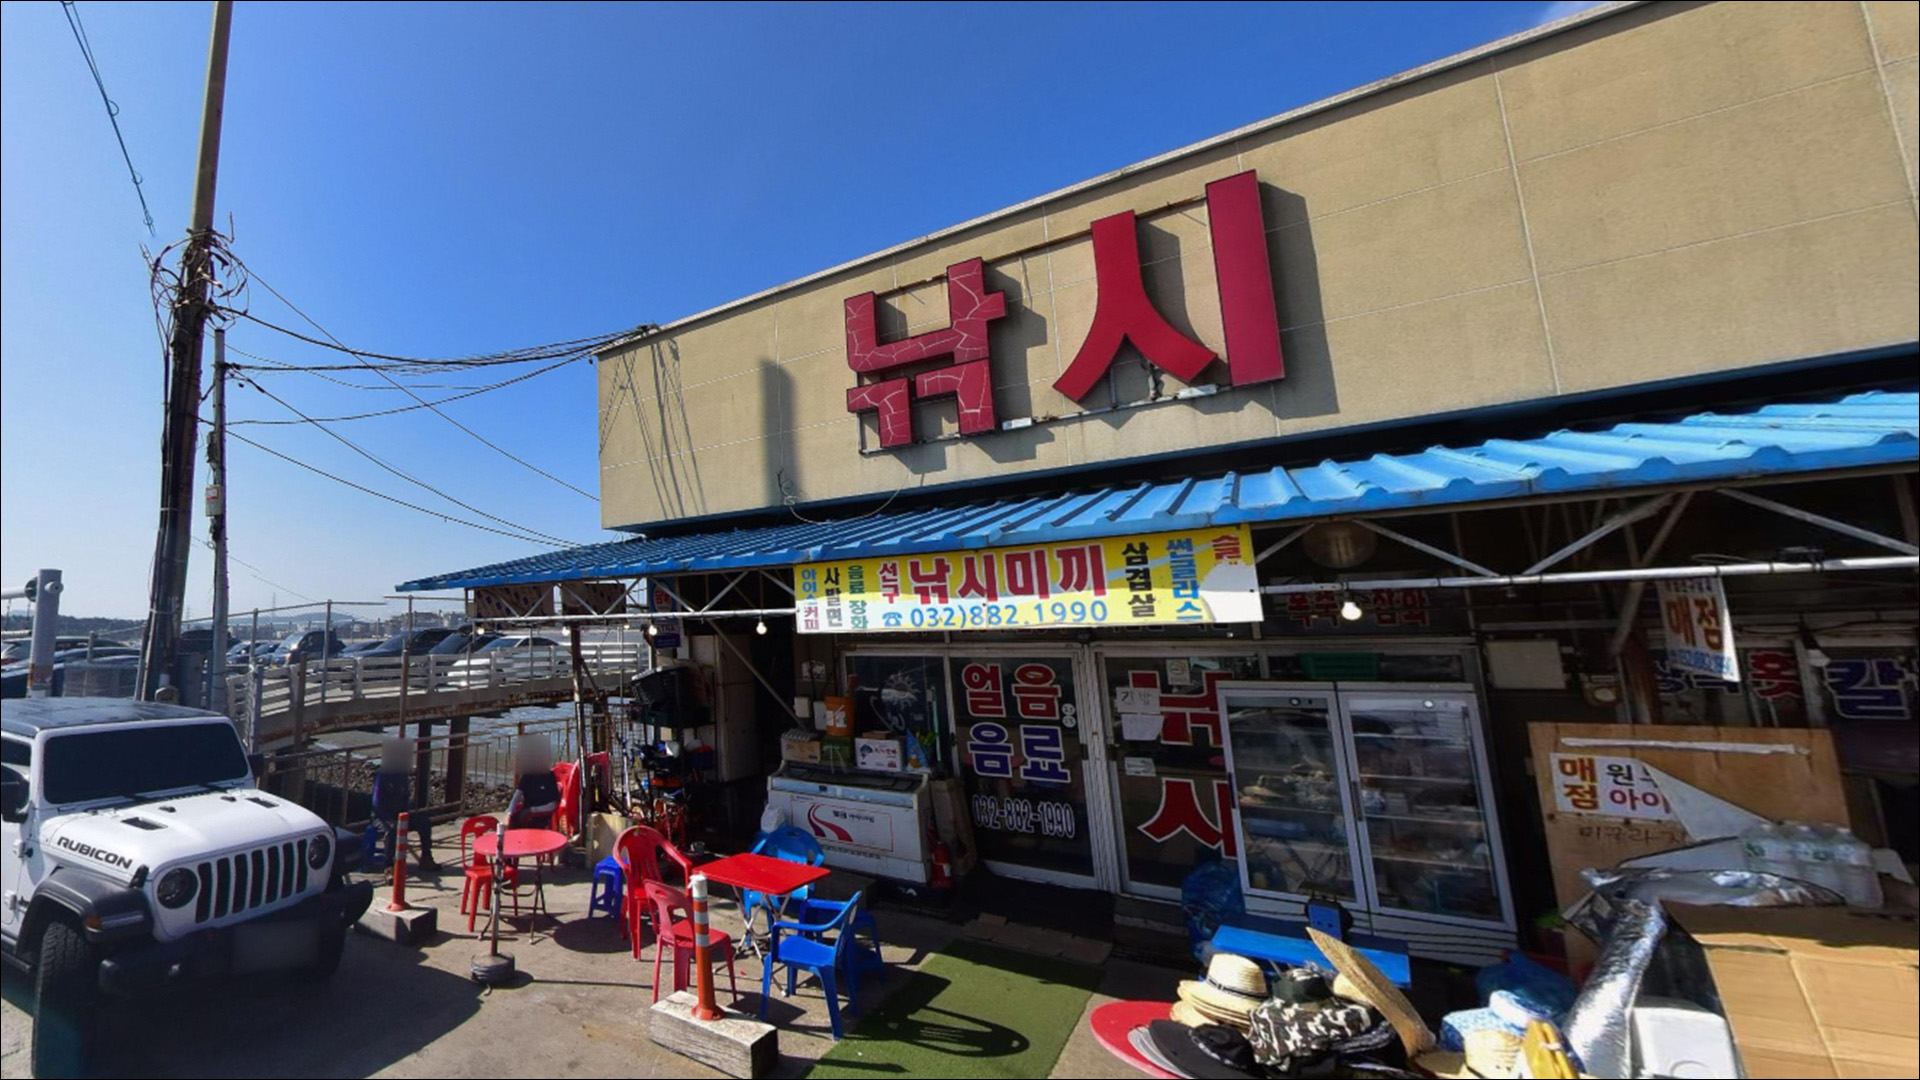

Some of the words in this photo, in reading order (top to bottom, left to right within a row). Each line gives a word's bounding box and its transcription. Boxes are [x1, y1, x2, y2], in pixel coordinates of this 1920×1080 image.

[844, 169, 1285, 447] 낚시
[824, 566, 843, 628] 사발면
[878, 561, 900, 604] 선구
[908, 545, 1107, 605] 낚시미끼
[1121, 541, 1156, 618] 삼겹살
[1166, 538, 1203, 623] 썬글라스
[849, 599, 869, 630] 장화
[909, 600, 1109, 629] 032)882.1990
[1664, 593, 1725, 653] 매점
[961, 662, 1062, 721] 얼음
[966, 721, 1073, 784] 음료
[1558, 757, 1599, 811] 매점
[972, 794, 1076, 839] 032-882-1990
[57, 836, 133, 870] RUBICON
